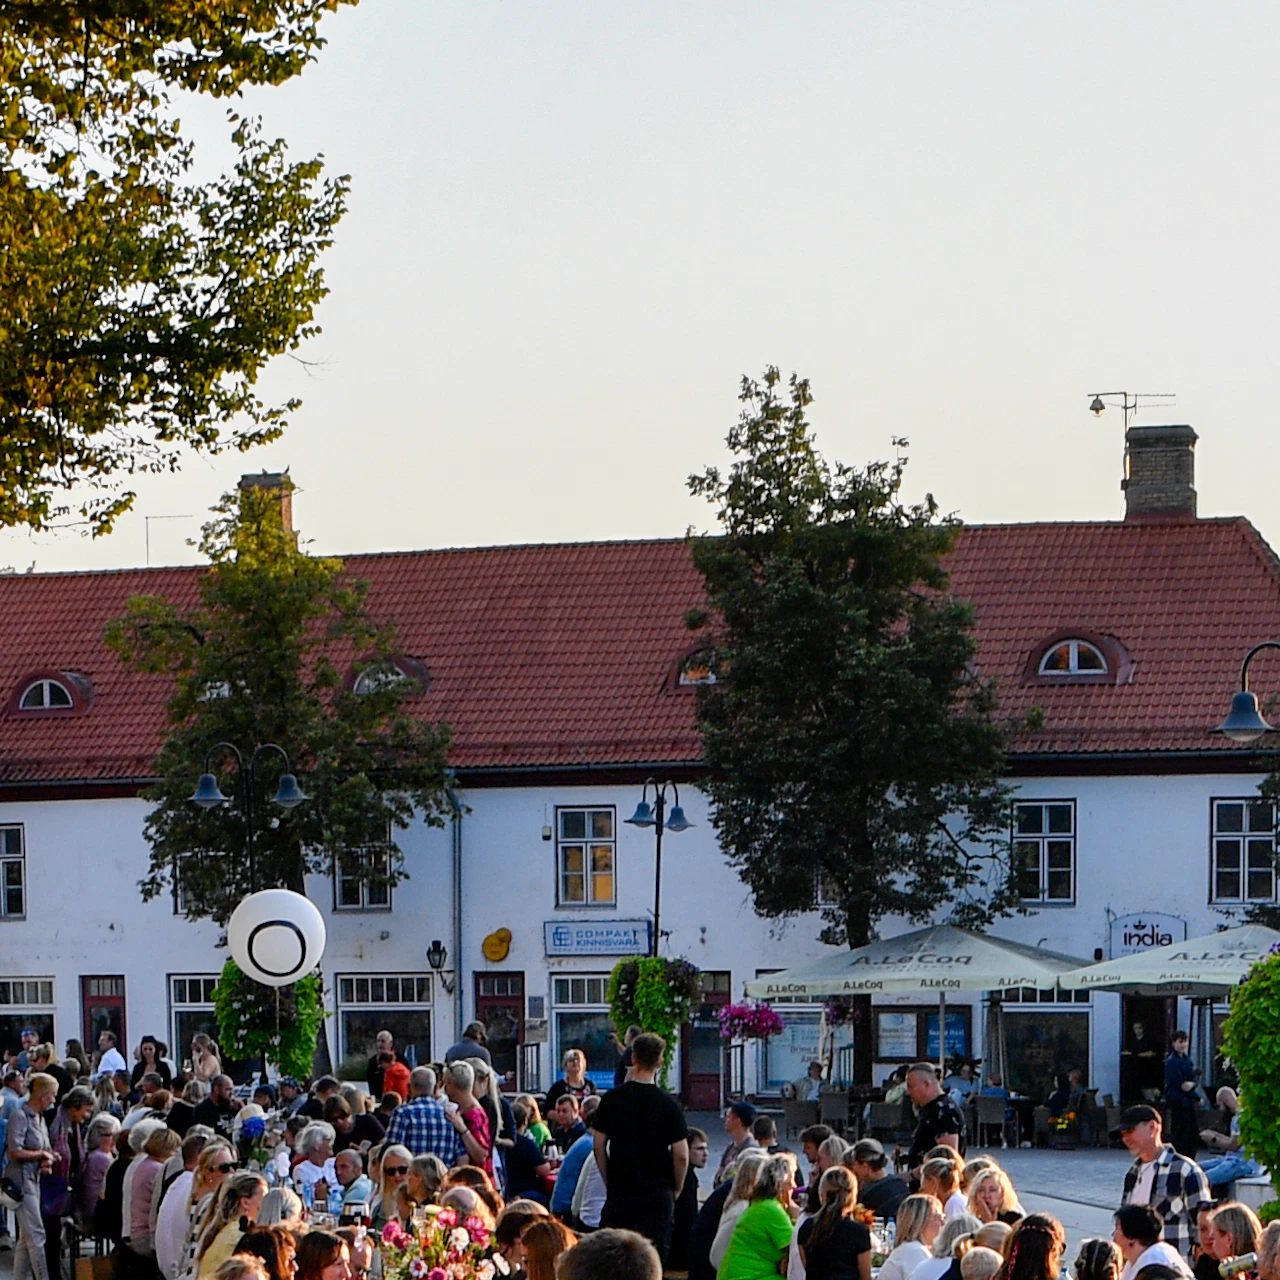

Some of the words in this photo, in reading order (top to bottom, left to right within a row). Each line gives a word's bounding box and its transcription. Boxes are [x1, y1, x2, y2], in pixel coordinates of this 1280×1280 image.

[576, 929, 638, 939] COMPAKT
[1123, 923, 1173, 947] india
[576, 938, 640, 947] KINNISVARA
